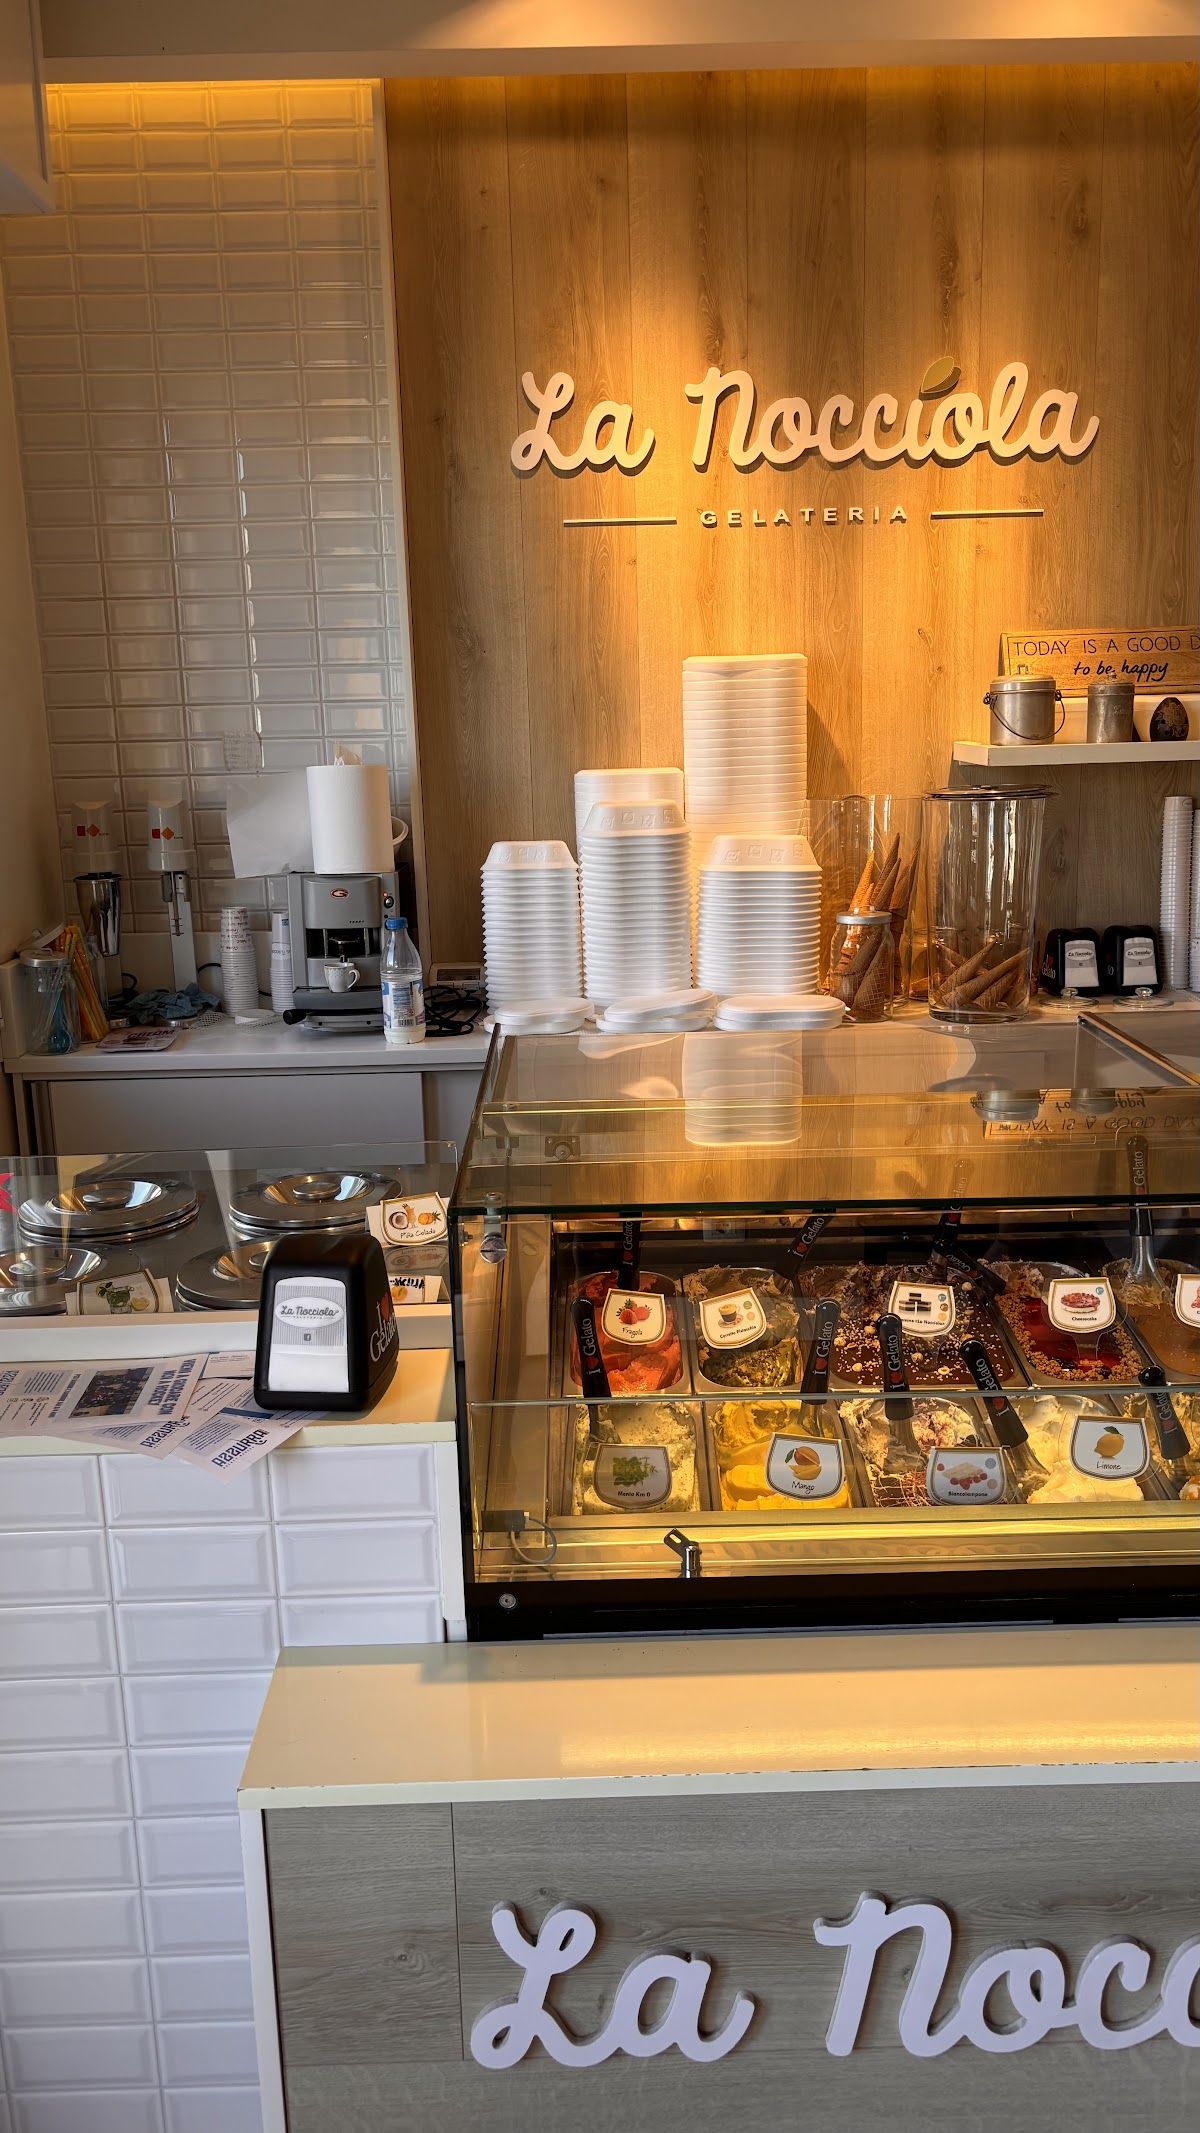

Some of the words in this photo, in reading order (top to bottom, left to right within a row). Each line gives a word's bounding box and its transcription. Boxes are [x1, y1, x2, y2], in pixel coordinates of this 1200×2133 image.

[511, 371, 655, 472] La
[685, 358, 1101, 467] Nocciola
[700, 505, 909, 527] GELATERIA
[1013, 640, 1070, 656] TODAY
[1083, 639, 1097, 654] IS
[1107, 639, 1119, 653] A
[1127, 636, 1181, 652] GOOD
[1073, 661, 1090, 676] to
[1096, 660, 1113, 675] be
[1121, 659, 1169, 682] happy
[1133, 1150, 1144, 1187] Gelato
[623, 1220, 633, 1251] Gelato
[801, 1217, 825, 1245] Gelato
[280, 1305, 294, 1315] La
[296, 1306, 335, 1316] Nocciola
[580, 1318, 596, 1356] Gelato
[622, 1327, 643, 1339] Fragola
[816, 1321, 834, 1358] Gelato
[886, 1335, 900, 1371] Gelato
[587, 1367, 601, 1376] I
[1096, 1461, 1122, 1470] Limone
[791, 1480, 815, 1495] Mango
[470, 1900, 755, 2069] La
